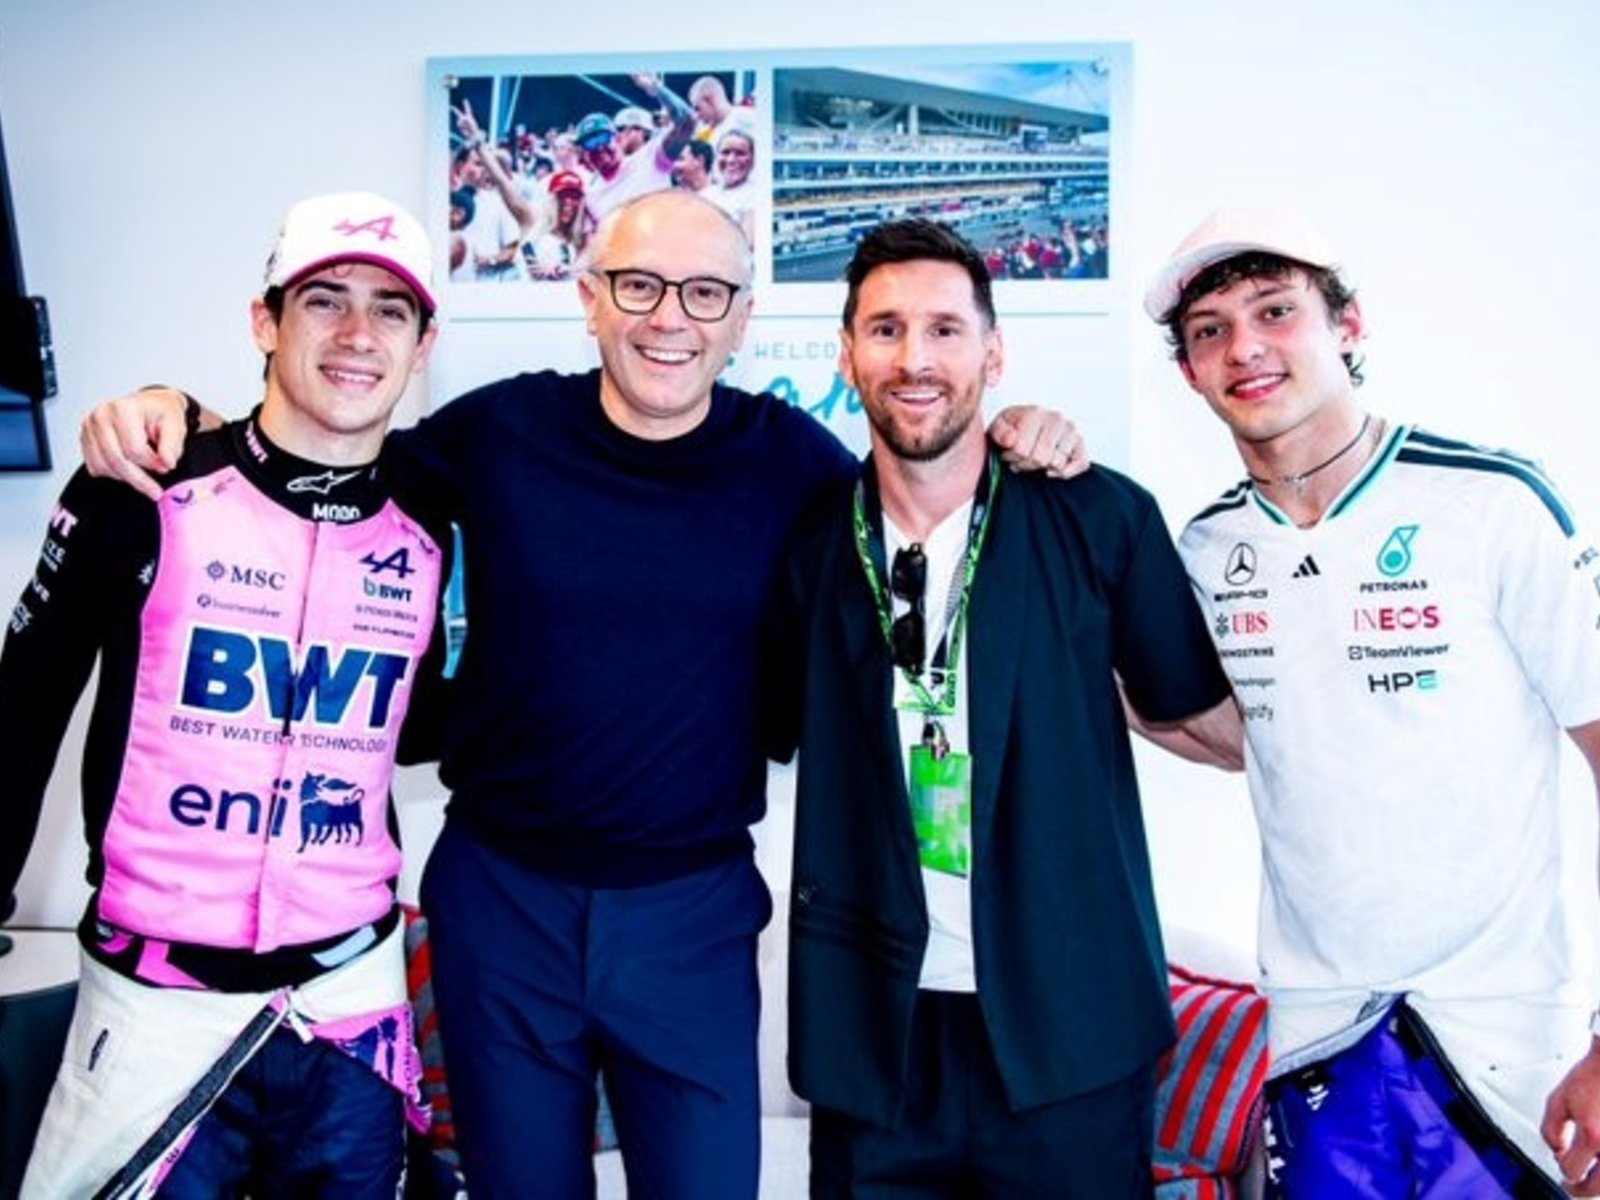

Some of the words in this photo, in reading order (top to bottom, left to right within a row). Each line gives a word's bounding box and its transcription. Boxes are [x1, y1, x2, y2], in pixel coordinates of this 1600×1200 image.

[231, 565, 286, 591] MSC
[1360, 580, 1428, 593] PETRONAS
[379, 584, 412, 602] BWT
[1232, 612, 1269, 634] UBS
[1353, 606, 1439, 631] INEOS
[1364, 644, 1449, 658] TeamViewer
[181, 627, 410, 729] BWT
[1368, 669, 1438, 693] HPE
[170, 715, 216, 736] BEST
[169, 778, 294, 837] eni
